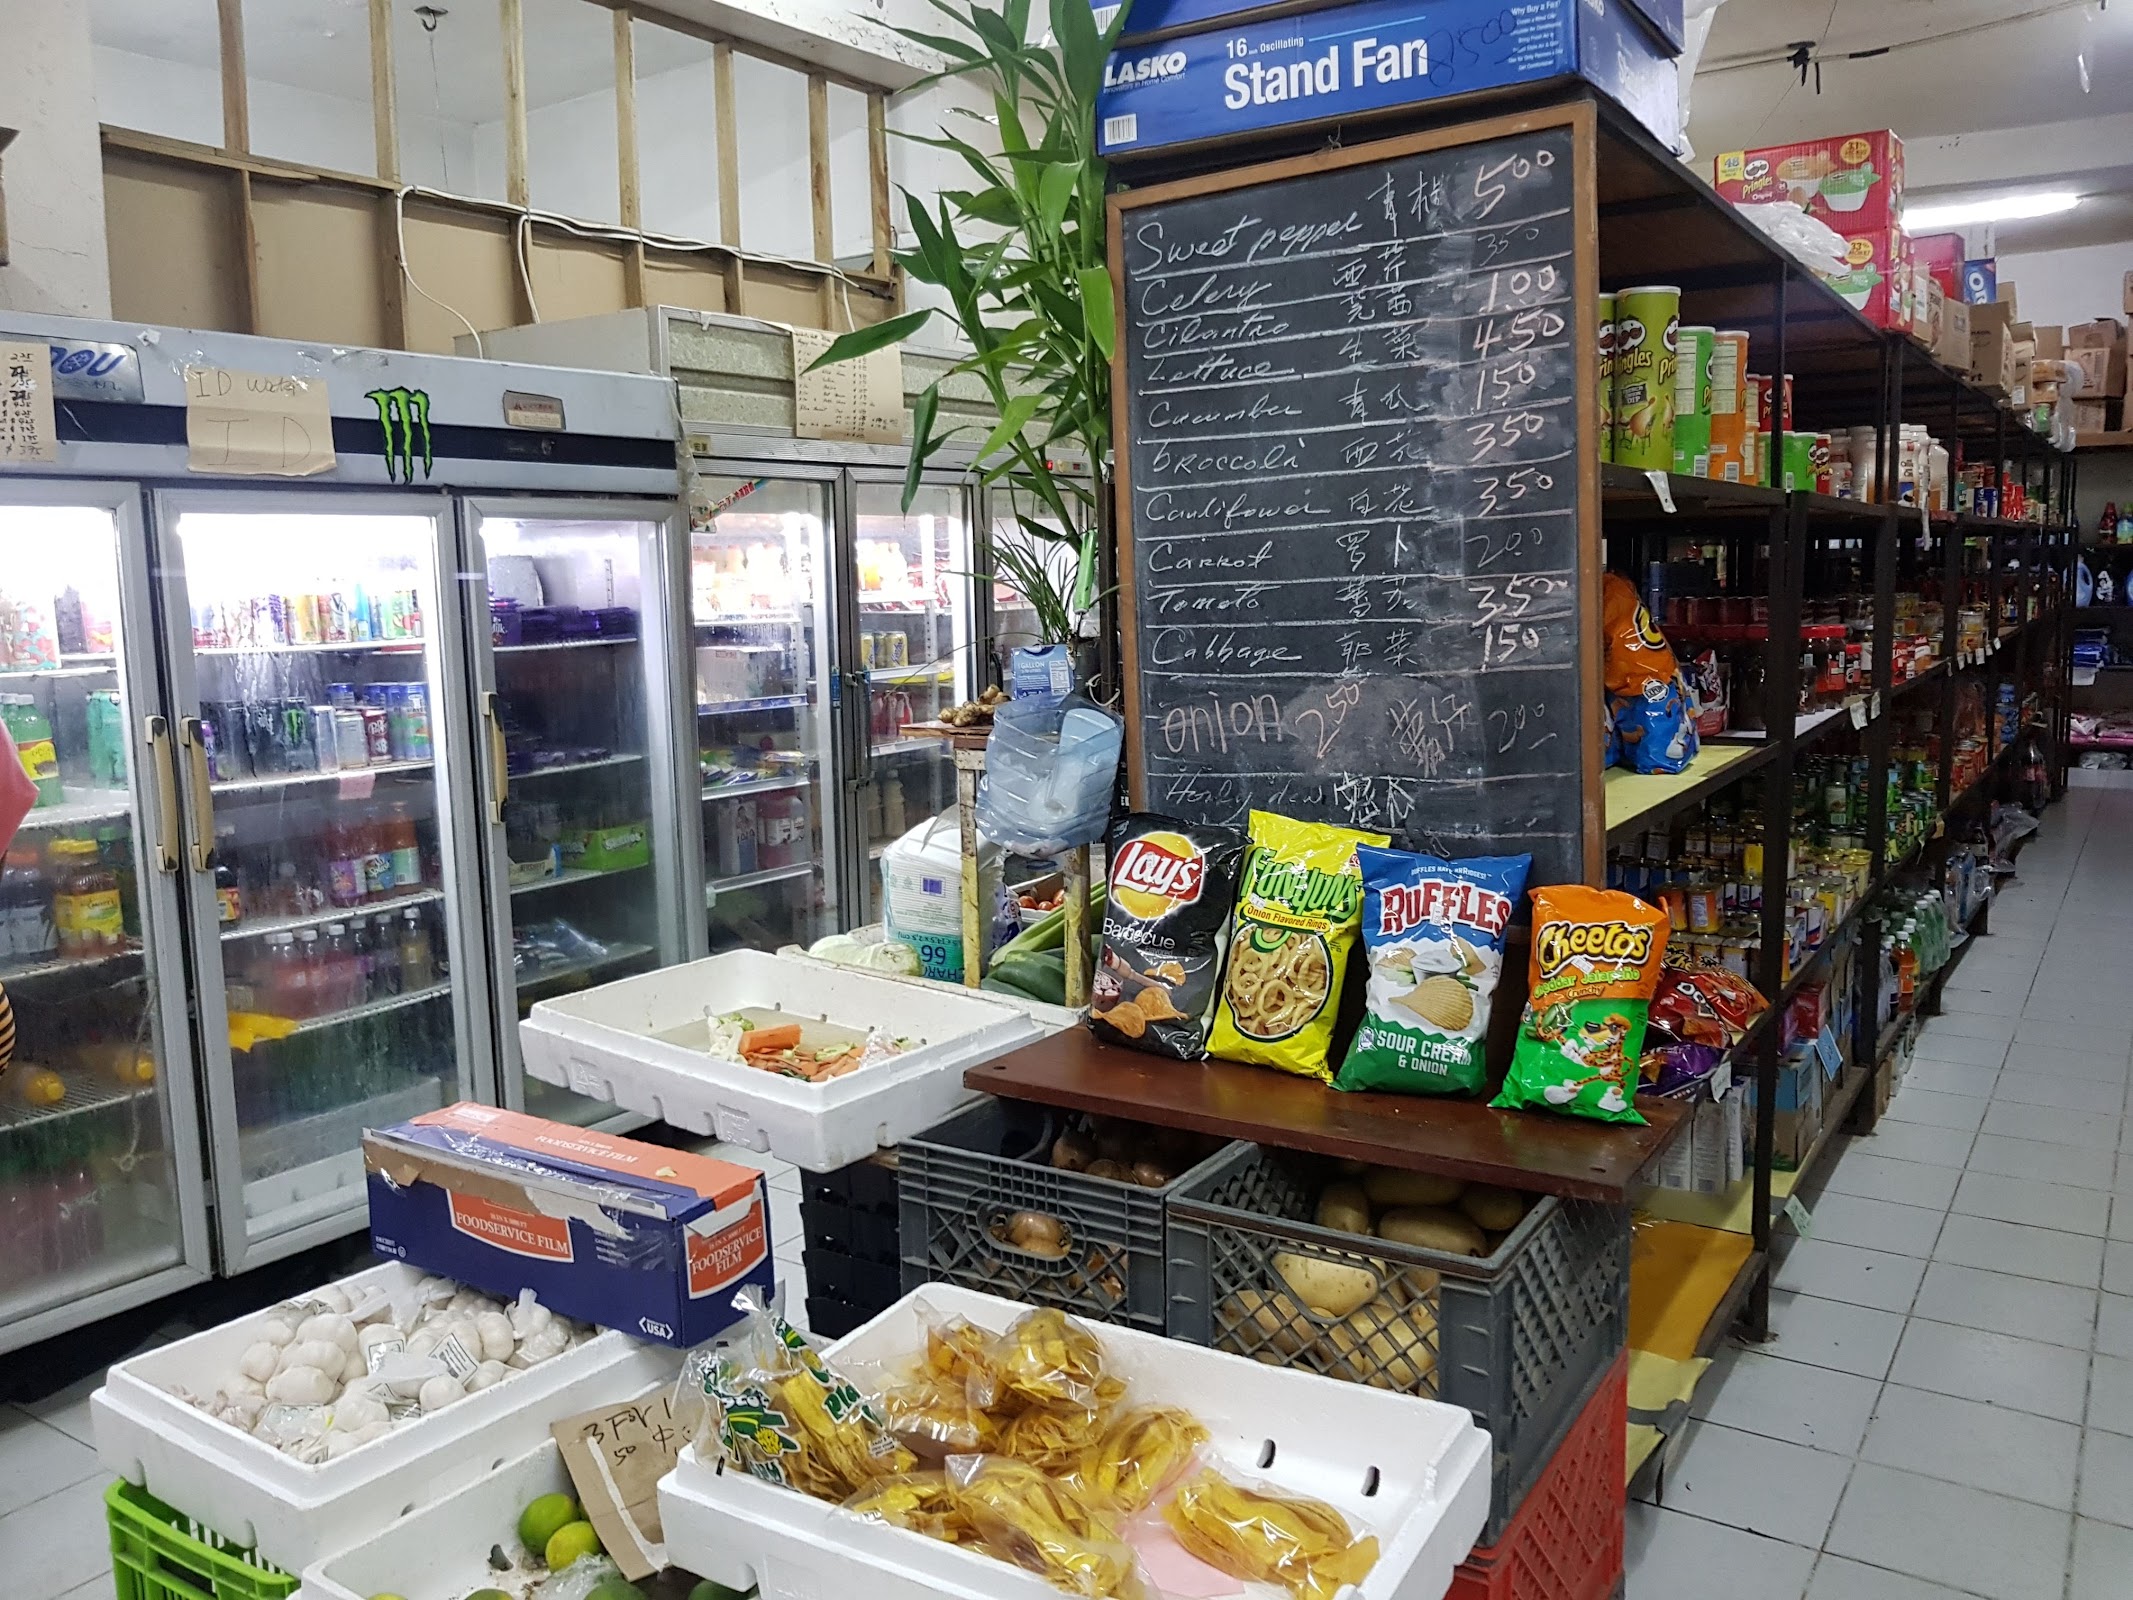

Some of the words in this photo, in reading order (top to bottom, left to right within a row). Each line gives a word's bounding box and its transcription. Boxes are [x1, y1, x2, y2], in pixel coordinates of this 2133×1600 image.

[1226, 38, 1247, 59] 16
[1260, 36, 1304, 53] Oscillating
[1103, 81, 1134, 94] Innovators
[1141, 77, 1161, 87] Home
[1161, 72, 1186, 84] Comfort
[1104, 51, 1187, 88] LASKO
[1224, 45, 1340, 111] Stand
[1352, 37, 1429, 87] Fan
[1742, 175, 1773, 200] Pringles
[1131, 215, 1262, 275] Sweet
[1474, 150, 1556, 220] 500
[1141, 273, 1272, 316] Celery
[1143, 311, 1290, 349] Cilantro
[1473, 307, 1566, 361] 450
[1472, 361, 1537, 411] 150
[1467, 411, 1545, 463] 350
[1473, 467, 1554, 518] 350
[1152, 627, 1303, 668] Cabbage
[1113, 842, 1200, 896] Lay's
[1411, 866, 1436, 876] RUFFLES
[1247, 905, 1271, 920] Onion
[1272, 912, 1305, 927] Flavored
[1305, 918, 1328, 931] Rings
[1382, 881, 1512, 935] RUFFLES
[1102, 917, 1176, 950] Barbecue
[1538, 923, 1649, 973] Cheetos
[1566, 985, 1606, 999] Crunchy
[1376, 1030, 1417, 1055] SOUR
[1398, 1055, 1408, 1068] &
[1411, 1057, 1448, 1077] ONION
[455, 1211, 537, 1246] FOODSERVICE
[537, 1234, 569, 1255] FILM
[692, 1226, 763, 1276] FOODSERVICE
[715, 1250, 742, 1276] FILM
[646, 1322, 667, 1339] USA
[583, 1422, 605, 1445] 3
[605, 1404, 653, 1441] For
[613, 1444, 638, 1467] 50
